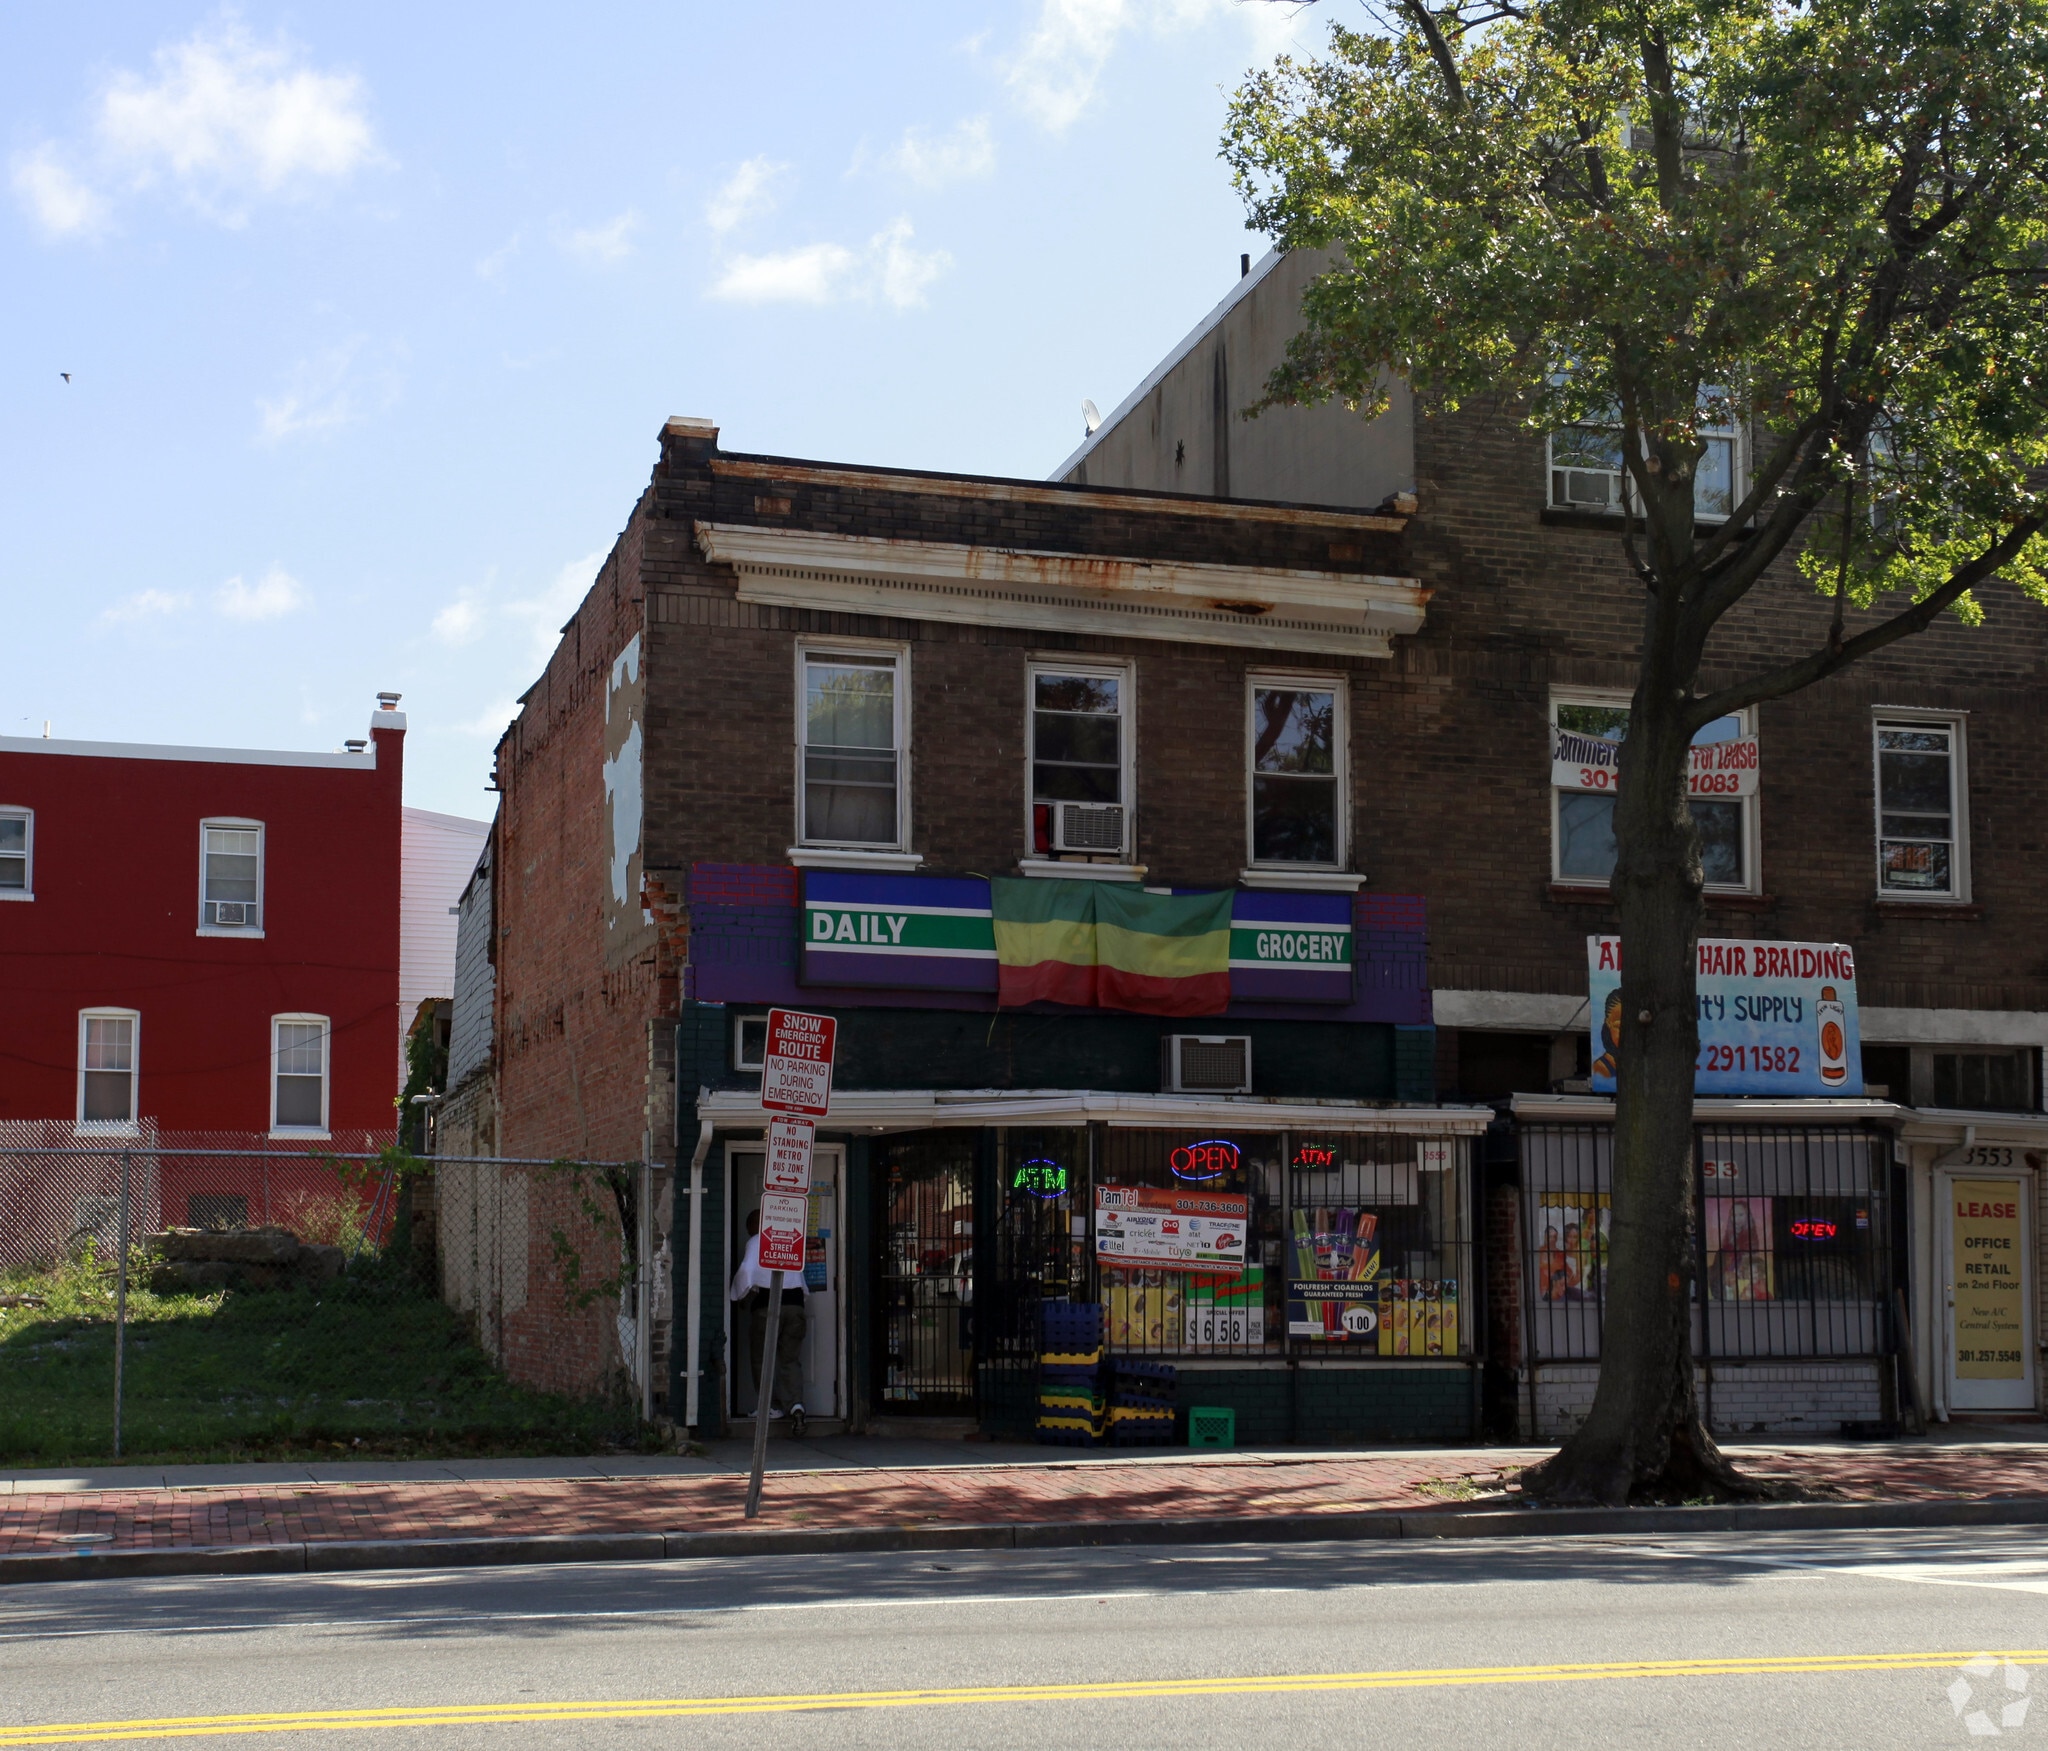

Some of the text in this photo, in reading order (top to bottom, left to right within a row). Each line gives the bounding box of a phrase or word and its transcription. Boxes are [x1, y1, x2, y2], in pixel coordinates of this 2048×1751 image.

[1689, 774, 1739, 793] 1083
[812, 912, 908, 944] DAILY
[1256, 932, 1345, 961] GROCERY
[1698, 945, 1747, 976] HAIR
[1753, 946, 1853, 980] BRAIDING
[783, 1014, 822, 1033] SNOW
[775, 1028, 827, 1044] EMERGENCY
[778, 1040, 821, 1060] ROUTE
[770, 1058, 826, 1077] NO PARKING
[780, 1073, 814, 1090] DURING
[768, 1086, 823, 1105] EMERGENCY
[786, 1126, 797, 1136] NO
[772, 1136, 809, 1150] STANDING
[776, 1149, 802, 1161] METRO
[1170, 1147, 1239, 1171] OPEN
[1293, 1149, 1333, 1166] ATM
[1960, 1147, 2013, 1167] 3553
[772, 1161, 804, 1174] BUS ZONE
[1013, 1167, 1067, 1190] ATM
[1098, 1187, 1138, 1206] TamTel
[769, 1205, 798, 1213] PARKING
[1176, 1199, 1245, 1214] 301-736-3600
[1957, 1202, 2016, 1219] LEASE
[1126, 1216, 1157, 1225] AIRVOICE
[1209, 1221, 1241, 1229] TRACFONE
[1129, 1229, 1156, 1239] cricket
[1790, 1222, 1838, 1237] OPEN
[770, 1242, 793, 1252] STREET
[1964, 1237, 2011, 1249] OFFICE
[763, 1251, 799, 1261] CLEANING
[1363, 1260, 1378, 1279] NEW!
[1965, 1263, 2011, 1275] RETAIL
[1333, 1283, 1374, 1292] CIGARILLOS
[1957, 1279, 2020, 1290] on 2nd Floor
[1303, 1290, 1364, 1299] GUARANTEED FRESH
[1971, 1307, 2008, 1317] New A/C
[1248, 1328, 1262, 1336] PECIAL
[1959, 1319, 2019, 1332] Central System
[1958, 1350, 2022, 1362] 301.257.5549
